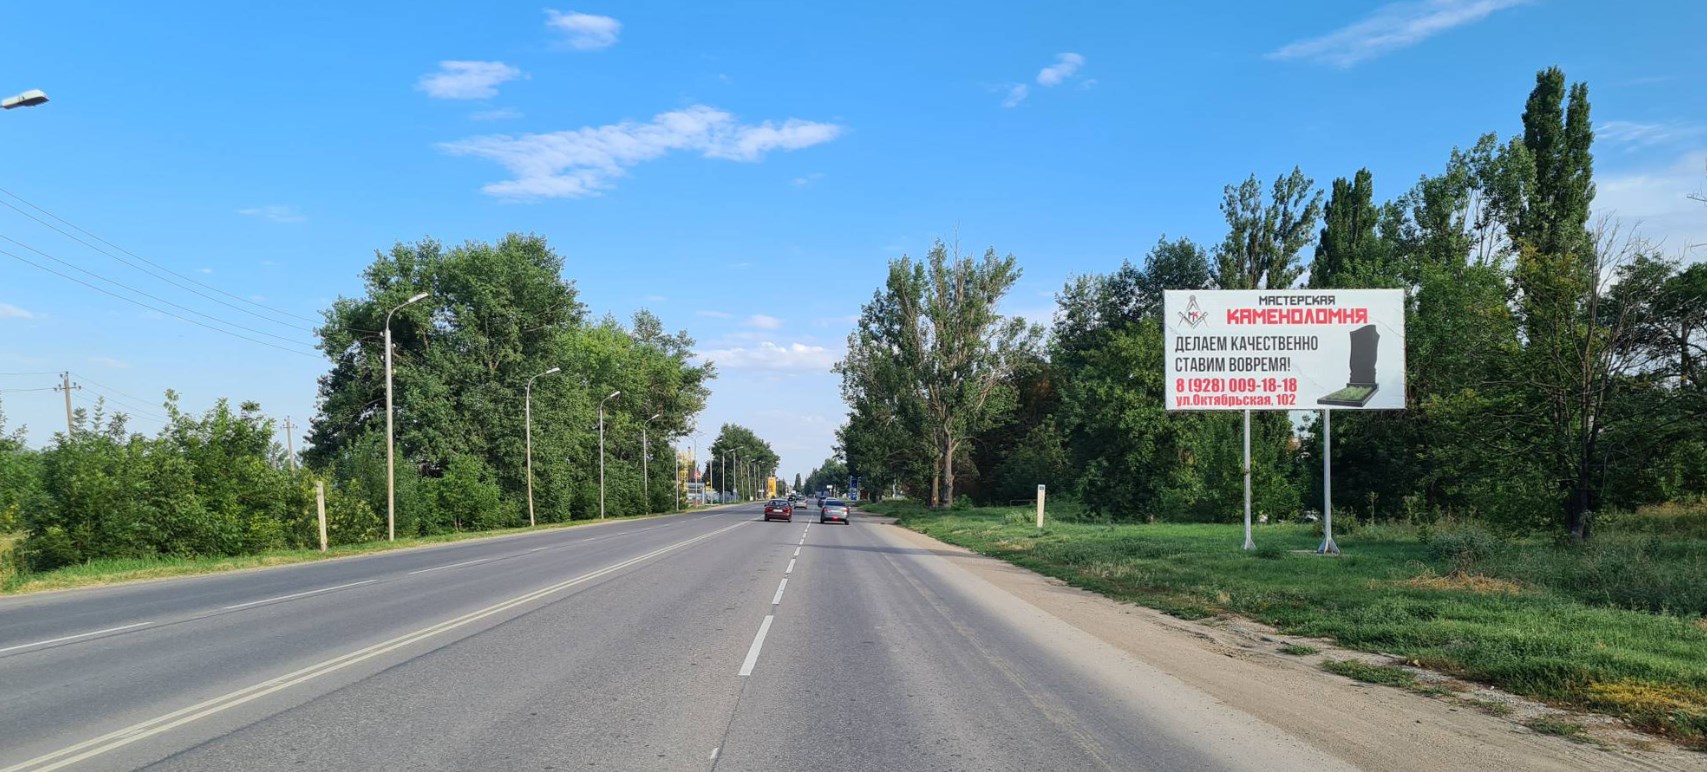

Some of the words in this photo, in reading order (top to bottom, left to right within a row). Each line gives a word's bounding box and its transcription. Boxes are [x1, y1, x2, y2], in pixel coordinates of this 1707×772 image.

[1258, 295, 1336, 306] МАСТЕРСКАЯ
[1226, 308, 1368, 325] КАМЕНОЛОМНЯ
[1175, 336, 1227, 353] ДЕЛАЕМ
[1231, 335, 1319, 351] КАЧЕСТВЕННО
[1175, 357, 1226, 372] СТАВИМ
[1229, 357, 1291, 372] ВОВРЕМЯ!
[1176, 379, 1185, 393] 8
[1188, 378, 1225, 393] (928)
[1228, 378, 1298, 393] 009-18-18
[1275, 394, 1296, 406] 102
